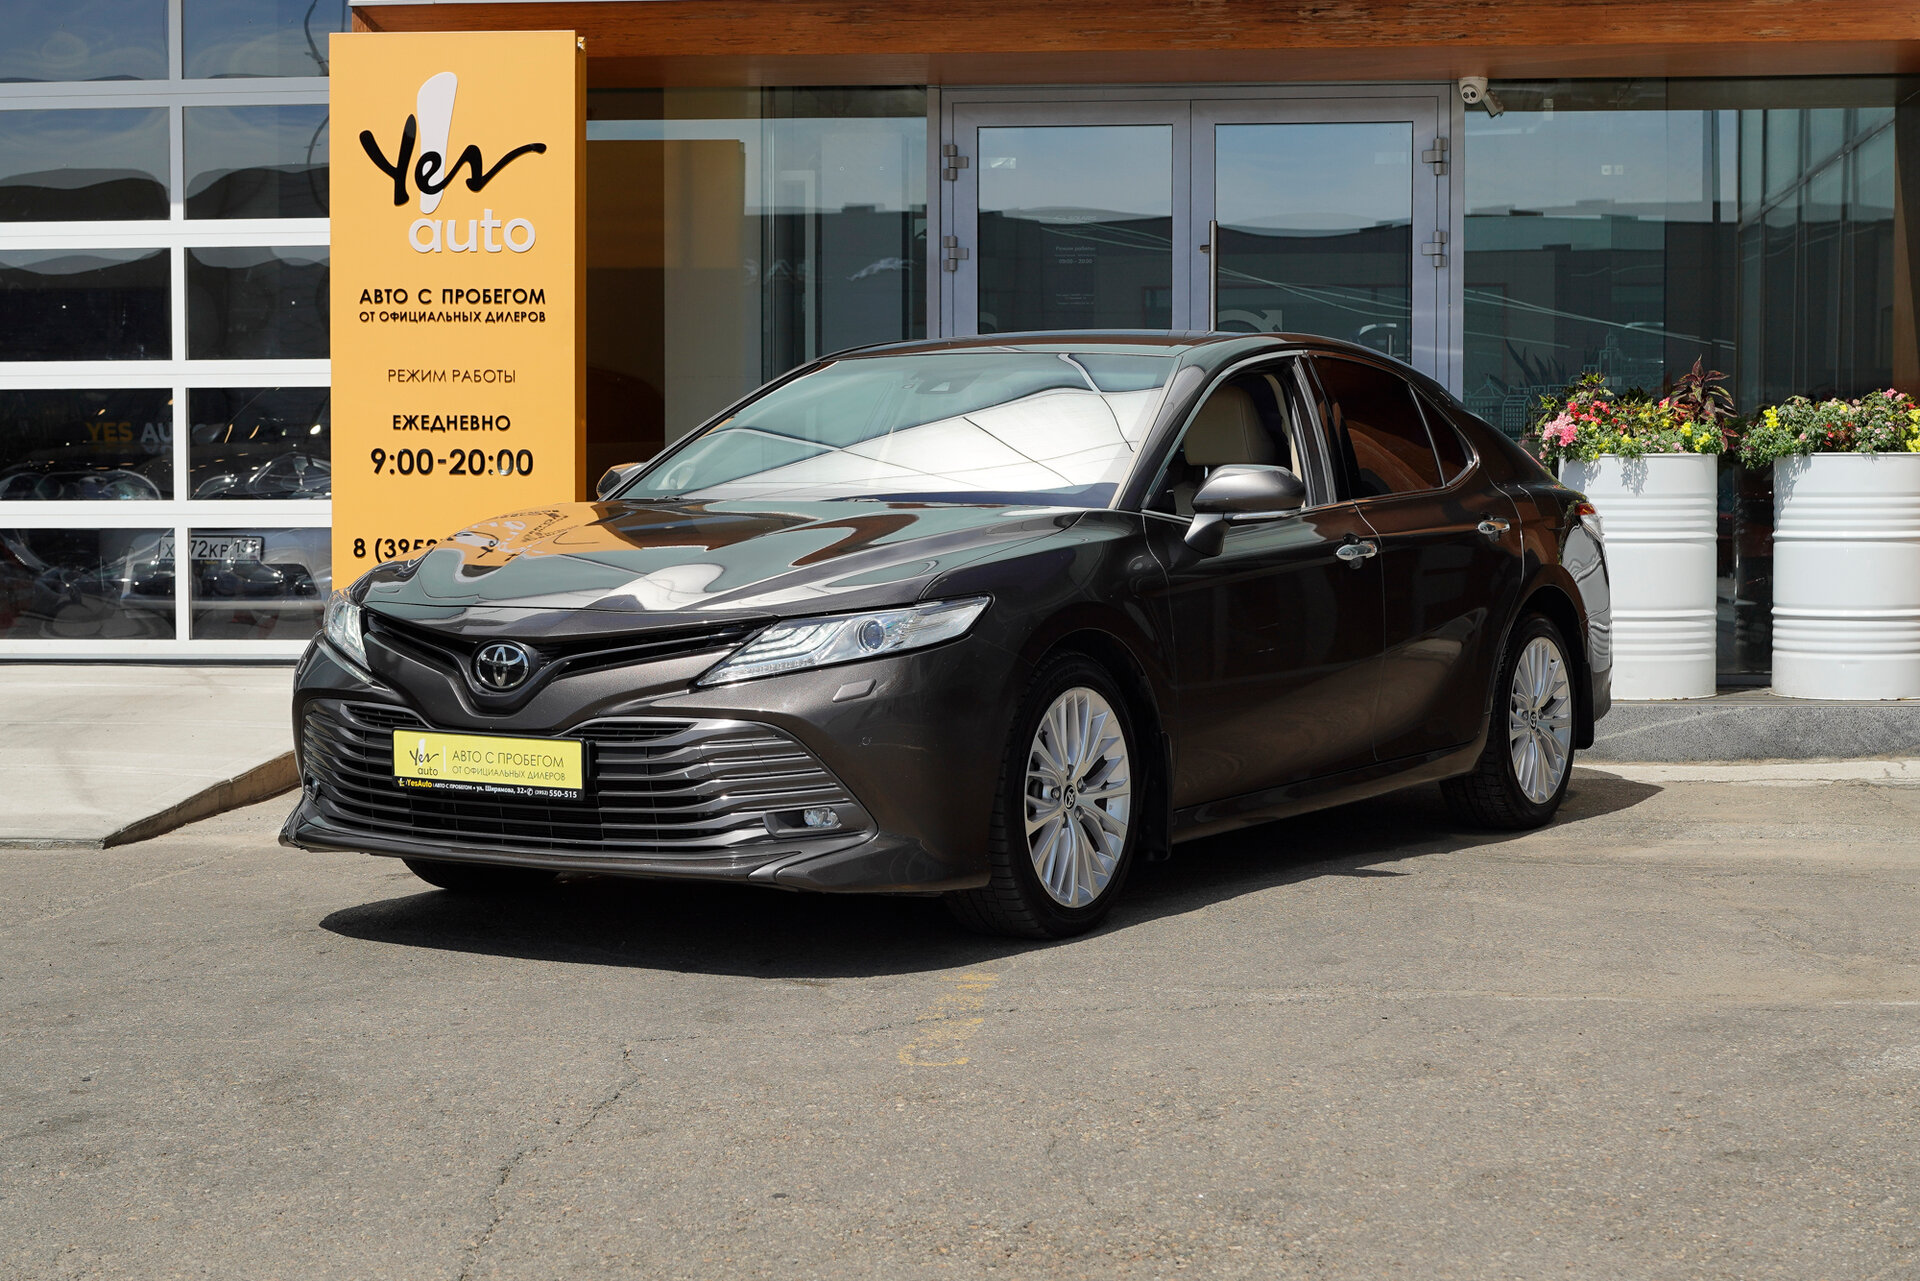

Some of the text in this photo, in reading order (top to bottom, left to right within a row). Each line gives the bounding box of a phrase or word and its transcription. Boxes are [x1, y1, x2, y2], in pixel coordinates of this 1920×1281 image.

[408, 209, 536, 253] auto
[359, 288, 546, 305] АВТО С ПРОБЕГОМ
[359, 311, 546, 324] ОТ ОФИЦИАЛЬНЫХ ДИЛЕРОВ
[388, 369, 516, 383] РЕЖИМ РАБОТЫ
[86, 422, 133, 442] YES
[392, 415, 511, 433] ЕЖЕДНЕВНО
[370, 448, 534, 476] 9:00-20:00
[353, 538, 366, 559] 8
[452, 750, 564, 767] АВТО С ПРОБЕГОМ
[417, 766, 439, 776] auto
[452, 766, 566, 781] ОТ ОФИЦИАЛЬНЫХ ДИЛЕРОВ
[549, 789, 578, 798] 550-515
